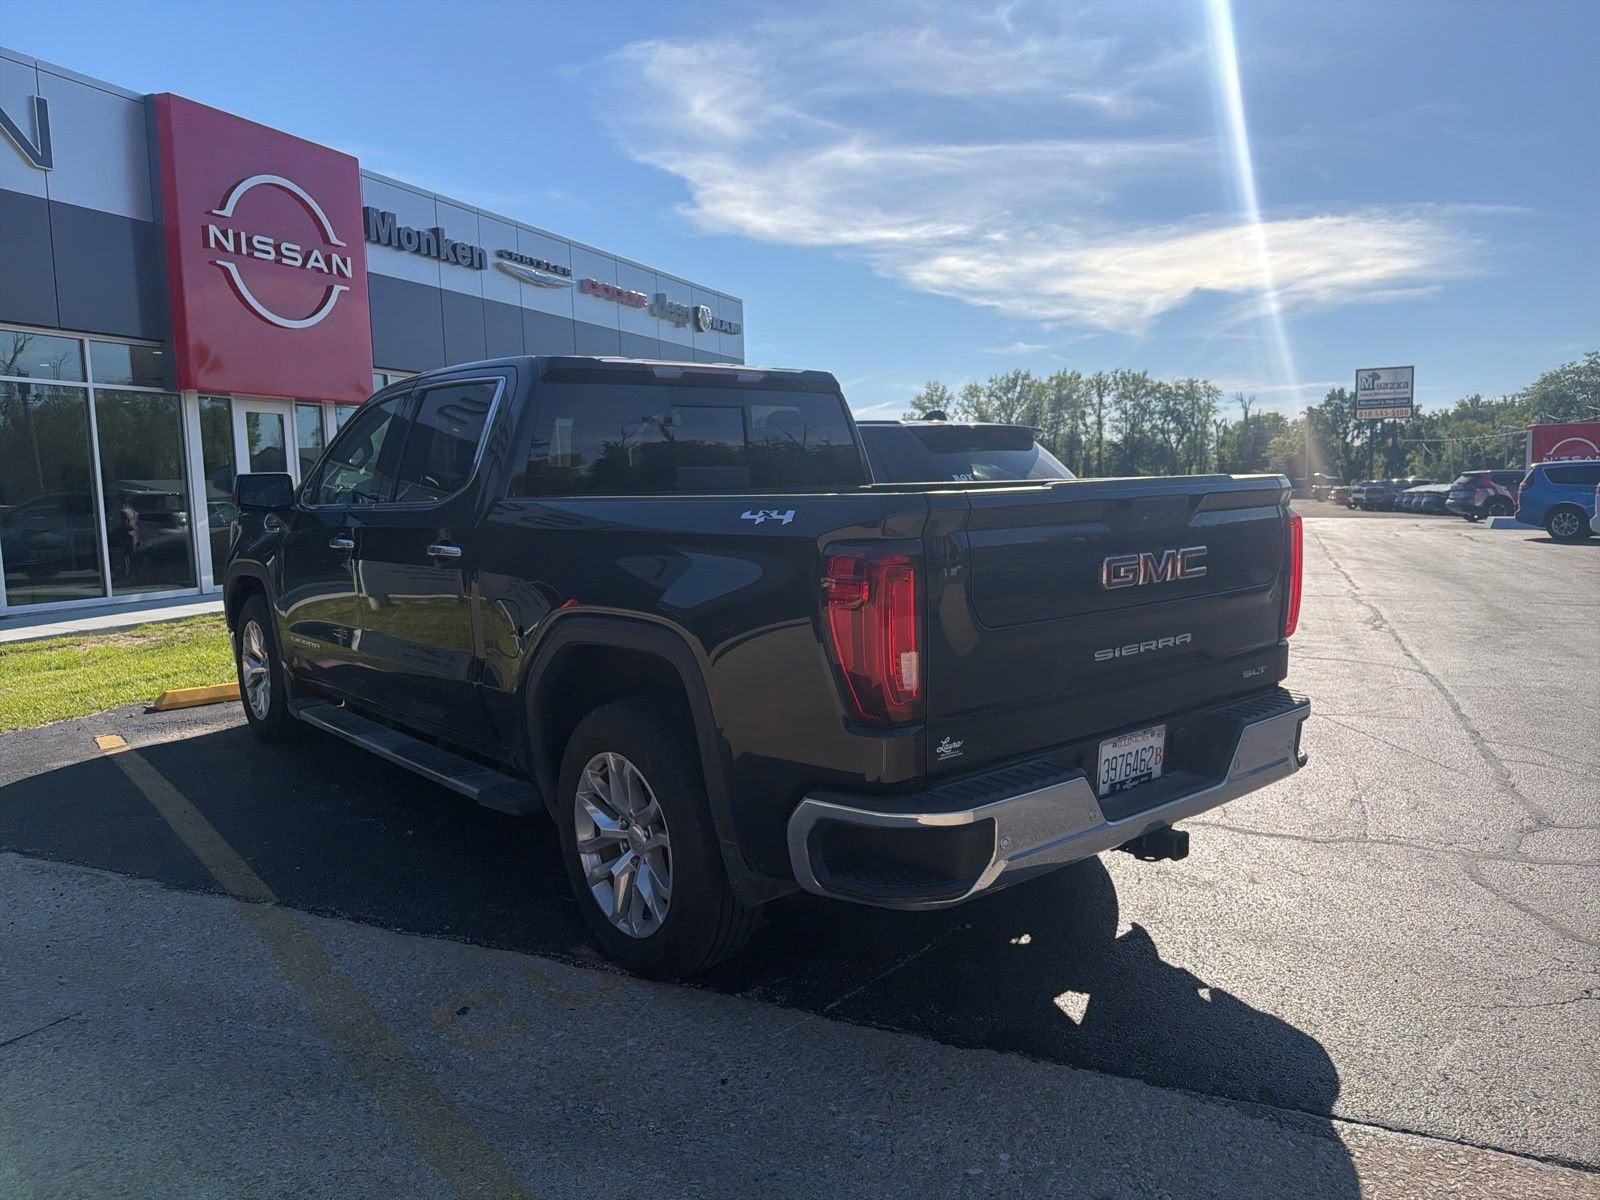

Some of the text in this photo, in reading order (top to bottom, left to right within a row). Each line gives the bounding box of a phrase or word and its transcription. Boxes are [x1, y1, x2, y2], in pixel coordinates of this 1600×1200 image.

[206, 224, 353, 279] NISSAN
[363, 205, 488, 271] Monken
[496, 248, 572, 277] CHRYSLER
[711, 315, 743, 336] RAM
[1102, 545, 1208, 590] GMC
[1094, 632, 1193, 662] SIERRA
[1241, 665, 1268, 679] SLT
[1102, 745, 1154, 785] 3976462
[1155, 746, 1162, 765] B
